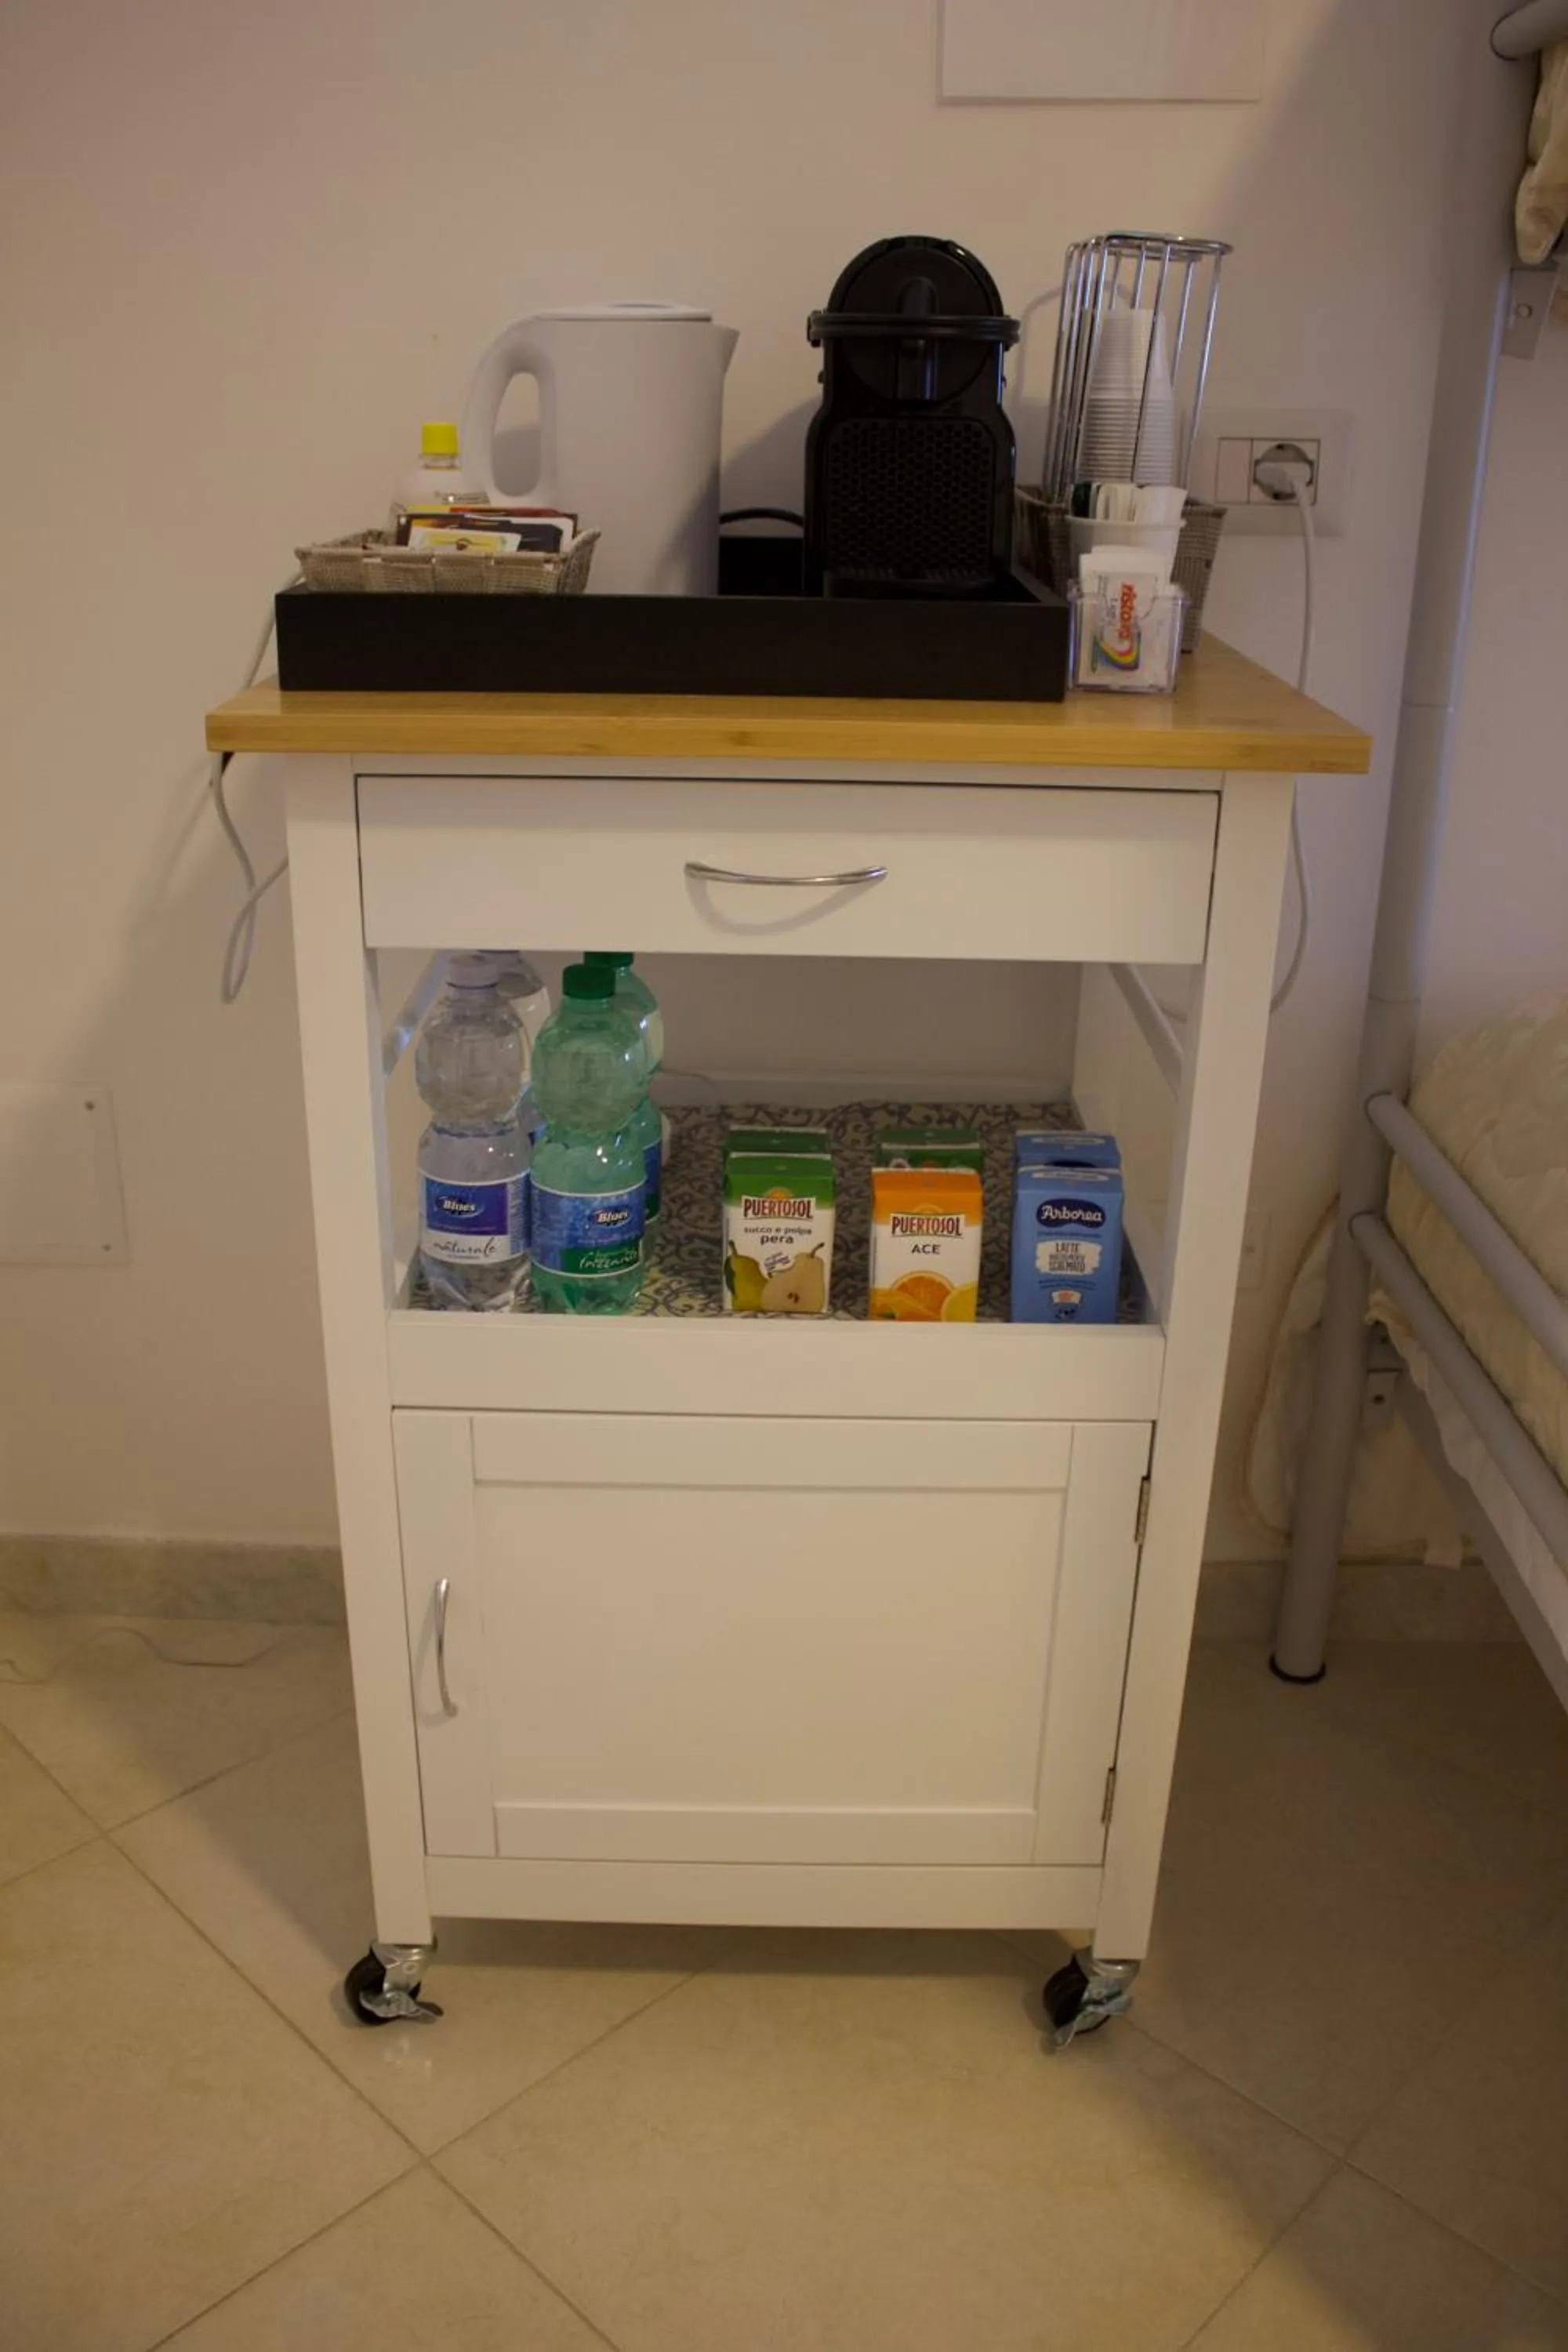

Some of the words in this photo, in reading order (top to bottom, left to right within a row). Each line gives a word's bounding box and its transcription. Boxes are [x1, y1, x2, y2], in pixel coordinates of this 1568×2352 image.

[443, 1200, 476, 1211] Blues
[743, 1198, 813, 1219] PUERTOSOL
[597, 1210, 628, 1222] Blues
[1041, 1204, 1102, 1221] Arborea
[891, 1216, 963, 1236] PUERTOSOL
[760, 1235, 794, 1246] pera
[911, 1243, 941, 1254] ACE
